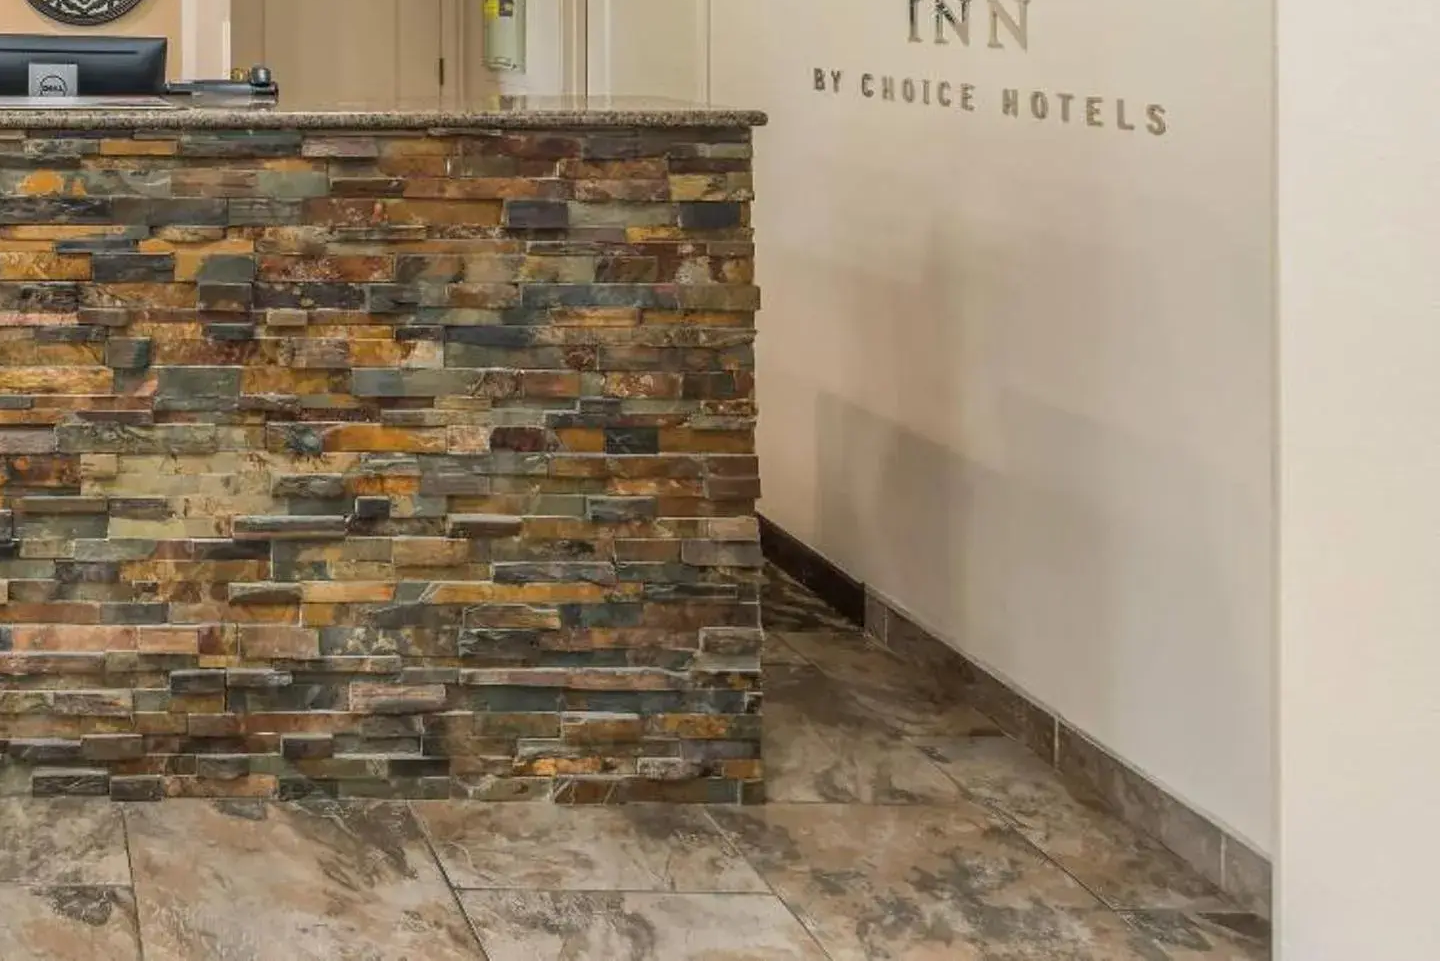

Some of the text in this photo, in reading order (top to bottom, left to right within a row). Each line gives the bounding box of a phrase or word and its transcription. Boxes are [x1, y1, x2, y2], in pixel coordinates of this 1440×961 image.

[813, 67, 1166, 136] BY CHOICE HOTELS
